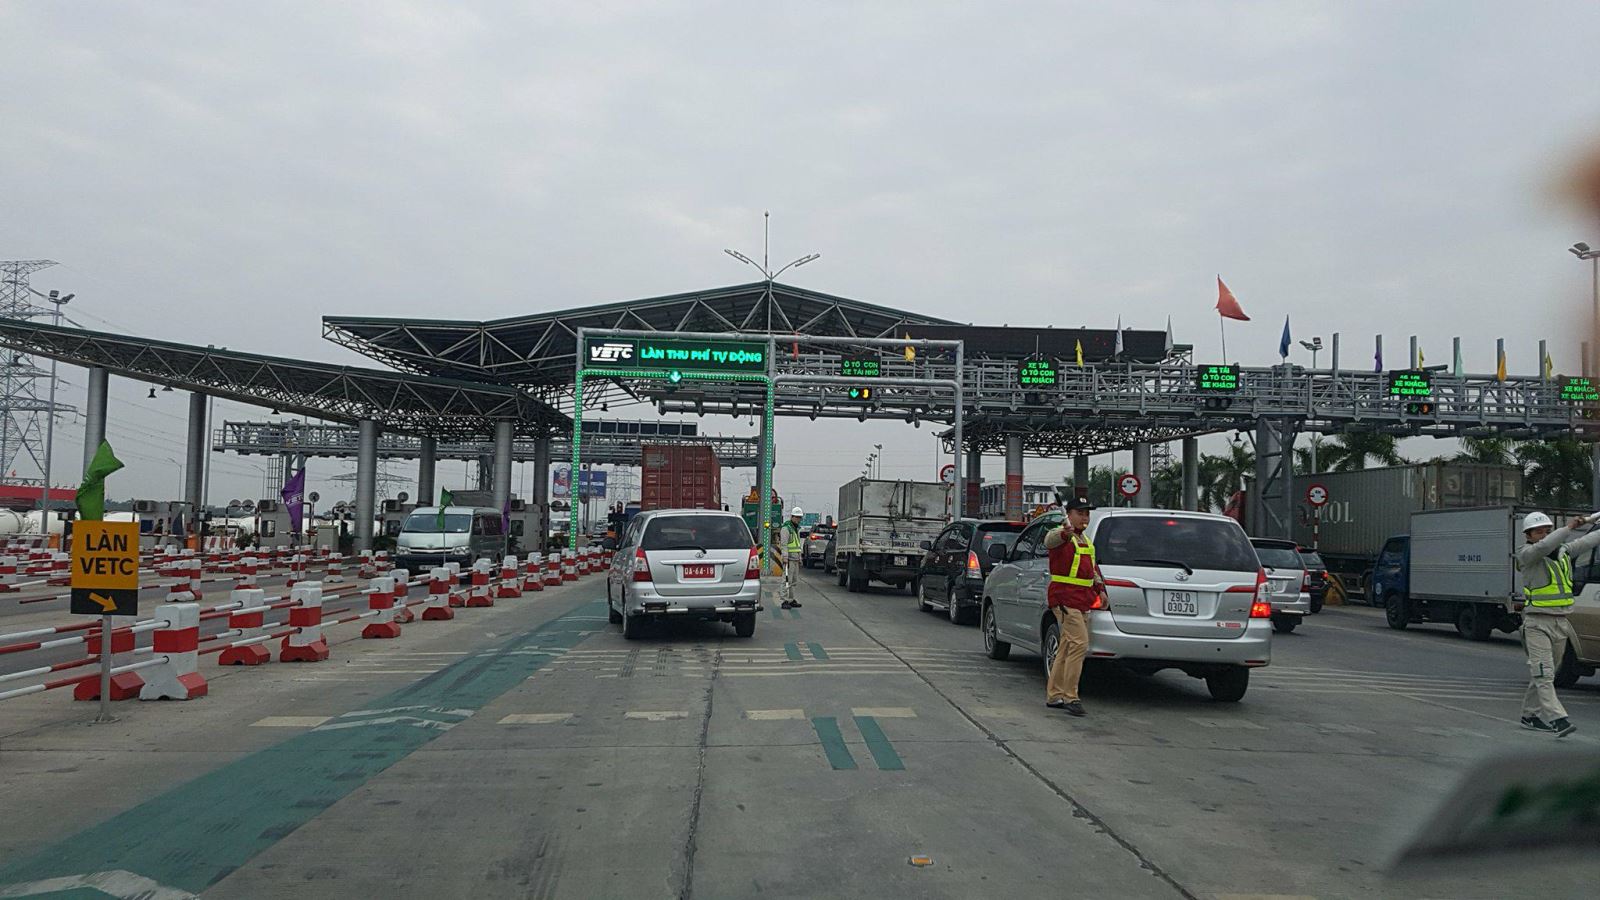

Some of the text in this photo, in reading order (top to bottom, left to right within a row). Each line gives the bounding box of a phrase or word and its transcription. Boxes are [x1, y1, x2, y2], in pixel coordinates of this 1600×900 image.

[591, 345, 633, 360] VETC
[641, 346, 763, 364] LÀN THU PHÍ TỰ ĐỘNG
[1208, 366, 1218, 374] XE
[1021, 376, 1031, 384] XE
[86, 529, 128, 552] LÀN
[80, 557, 134, 575] VETC
[1170, 592, 1191, 602] 29LD
[1167, 602, 1195, 613] 030.70
